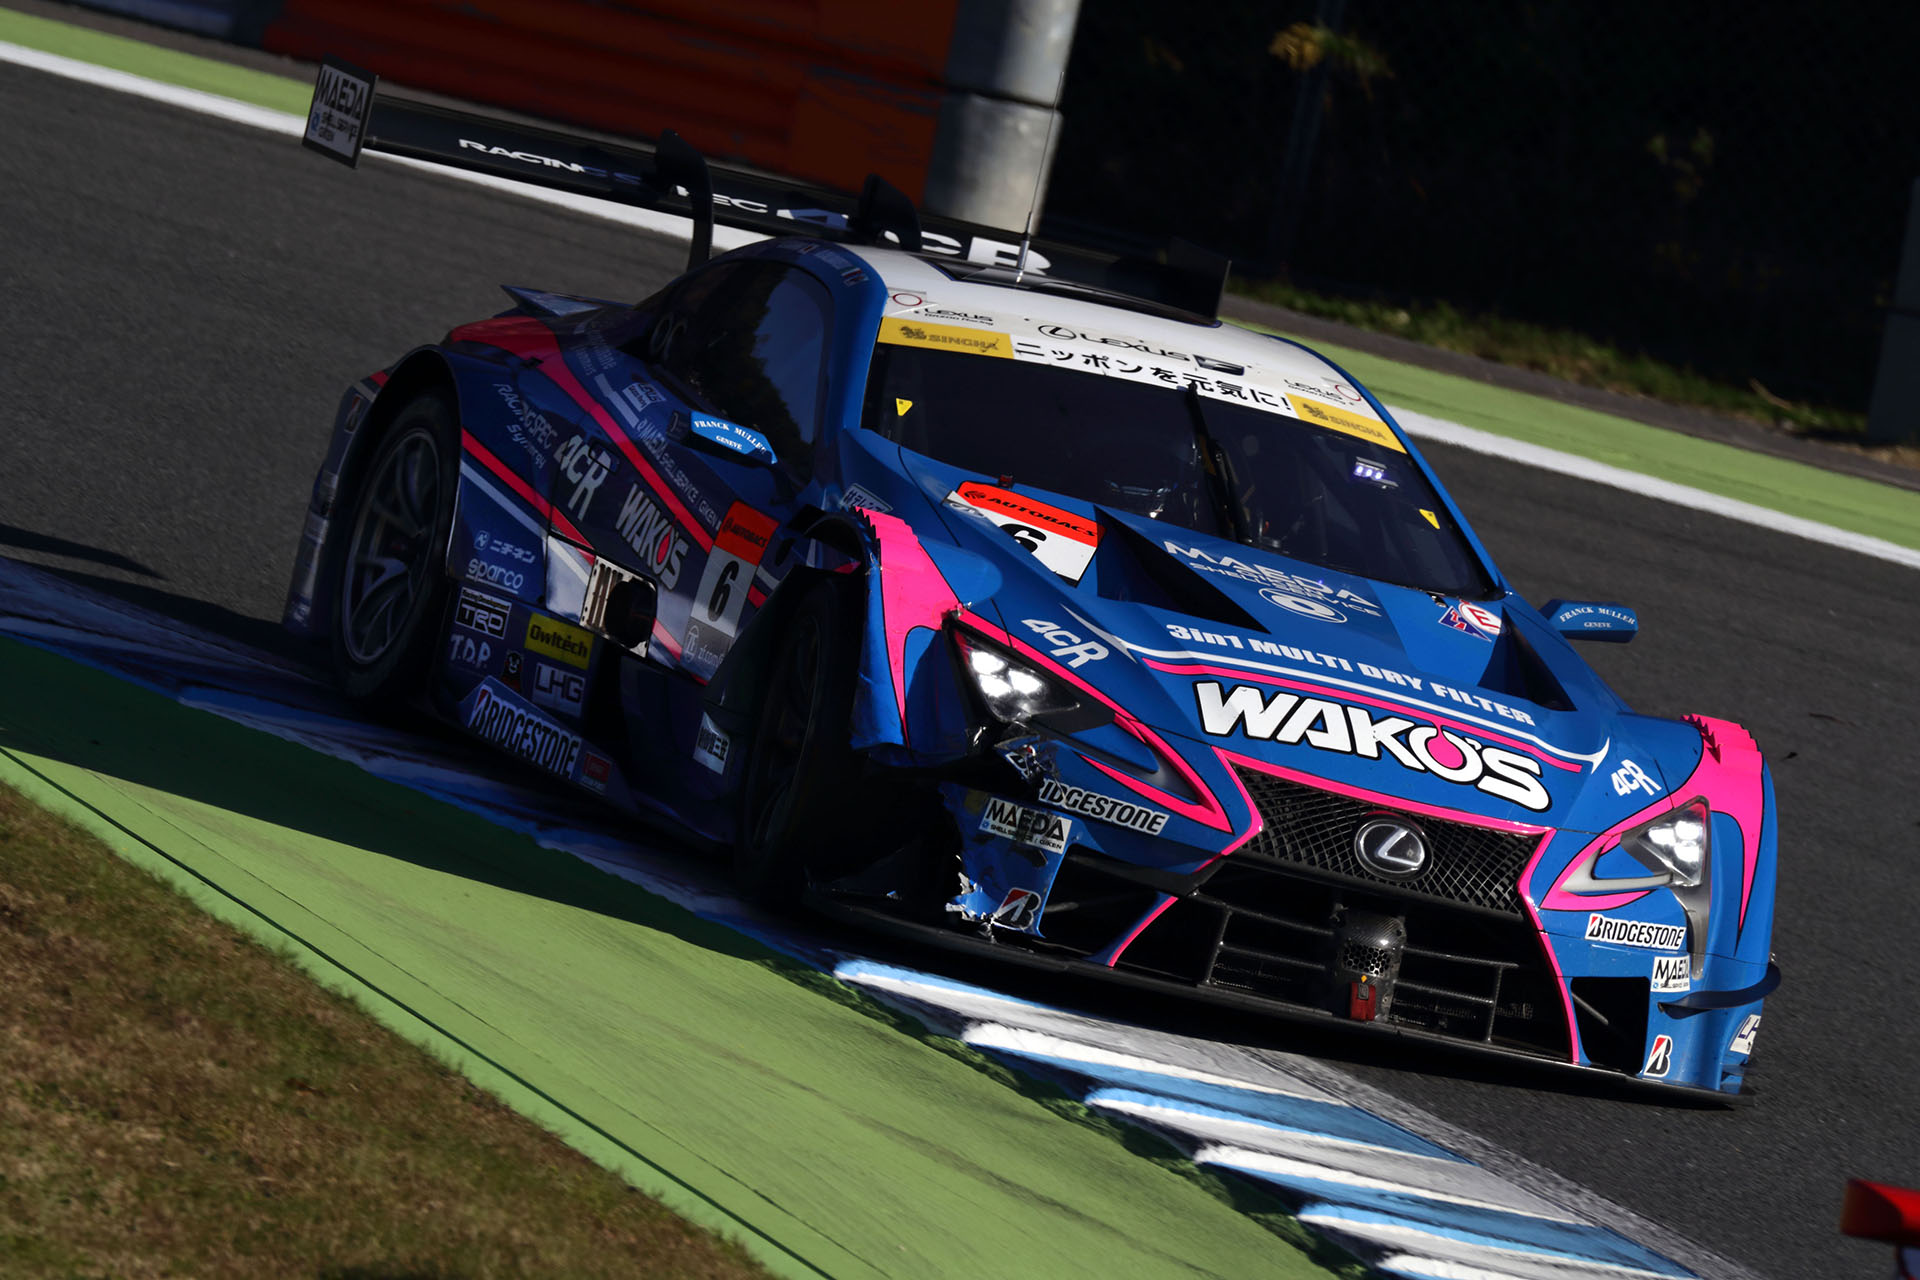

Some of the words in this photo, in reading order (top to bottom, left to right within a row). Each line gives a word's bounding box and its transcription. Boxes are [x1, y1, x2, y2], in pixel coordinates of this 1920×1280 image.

[315, 69, 363, 120] MAEDA
[459, 138, 608, 178] RACING
[613, 170, 768, 215] SEC
[924, 308, 993, 322] LEXUS
[929, 334, 1000, 352] SINGHA
[1080, 332, 1191, 362] LEXUS
[639, 421, 669, 461] MAEDA
[694, 420, 730, 431] FRANCK
[733, 427, 767, 454] MULLER
[553, 433, 613, 521] 4CR
[984, 497, 1097, 538] AUTOBACS
[1000, 523, 1047, 555] 6
[466, 556, 525, 590] sparco
[708, 560, 740, 622] 6
[1163, 540, 1382, 610] MAEDA
[458, 602, 505, 635] TRD
[1559, 605, 1595, 624] FRANCK
[1598, 607, 1636, 626] MULLER
[530, 623, 590, 660] Owltech
[1020, 617, 1110, 669] 4CR
[535, 664, 587, 703] LHG
[1166, 623, 1245, 651] 3in1
[1248, 638, 1353, 673] MULTI
[1357, 661, 1425, 692] DRY
[1430, 680, 1536, 727] FILTER
[467, 686, 582, 780] BRIDGESTONE
[1610, 759, 1662, 797] 4CR
[985, 800, 1065, 842] MAEDA
[1587, 915, 1686, 949] BRIDGESTONE
